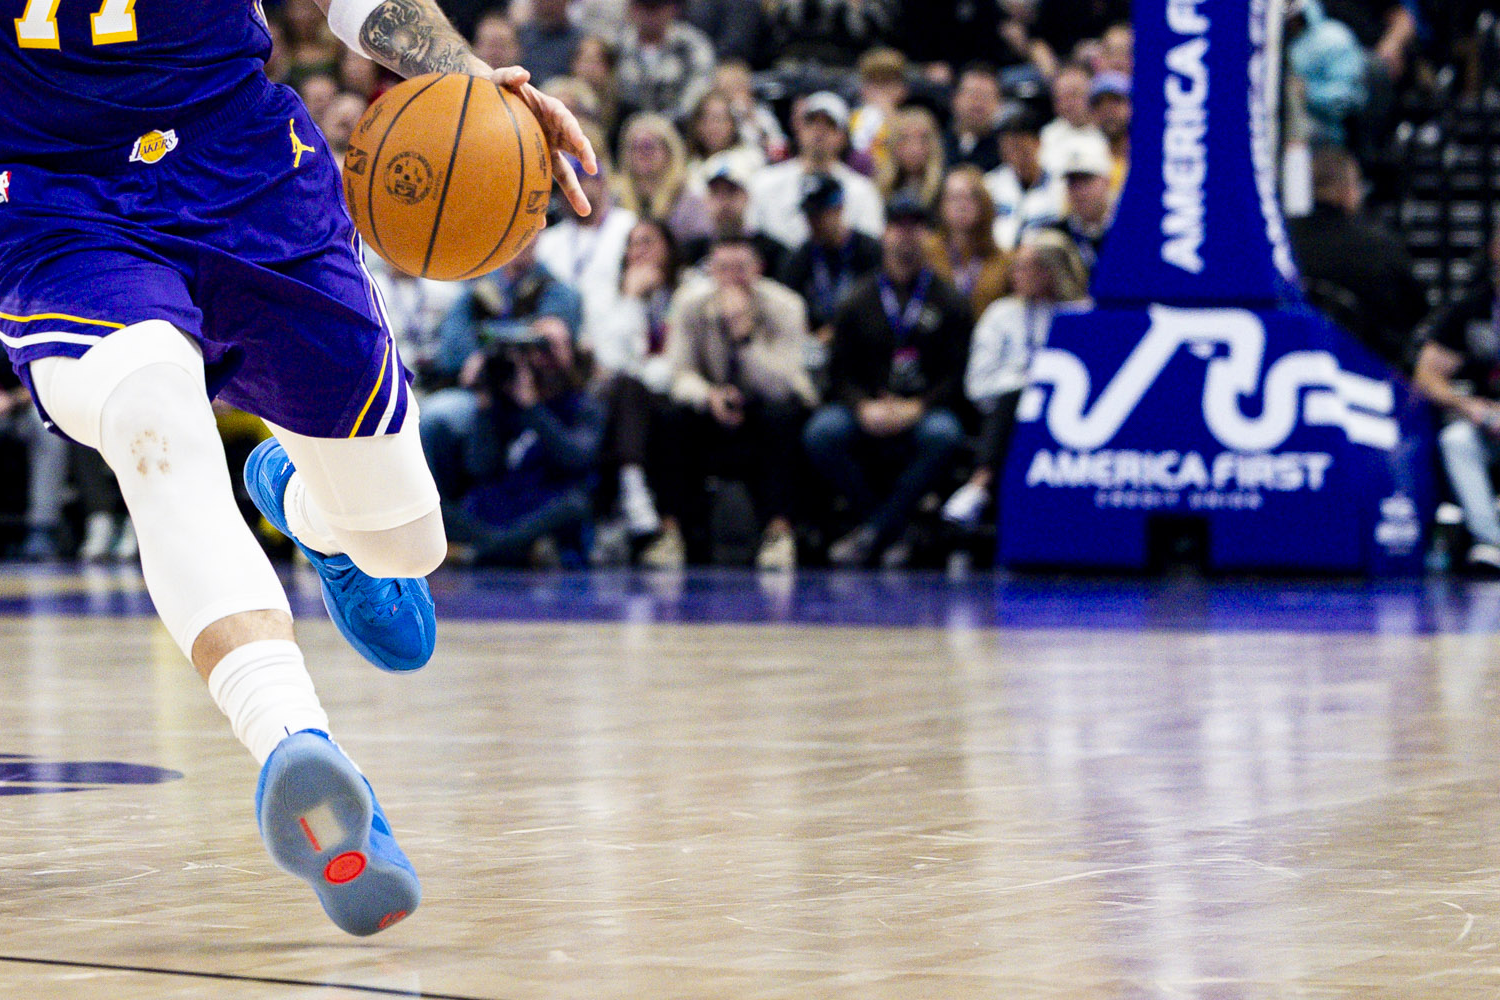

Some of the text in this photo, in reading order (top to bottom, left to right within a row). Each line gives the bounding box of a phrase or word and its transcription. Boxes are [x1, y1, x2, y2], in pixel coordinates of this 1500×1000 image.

[1160, 38, 1209, 275] AMERICA
[1026, 449, 1333, 491] AMERICA FIRST
